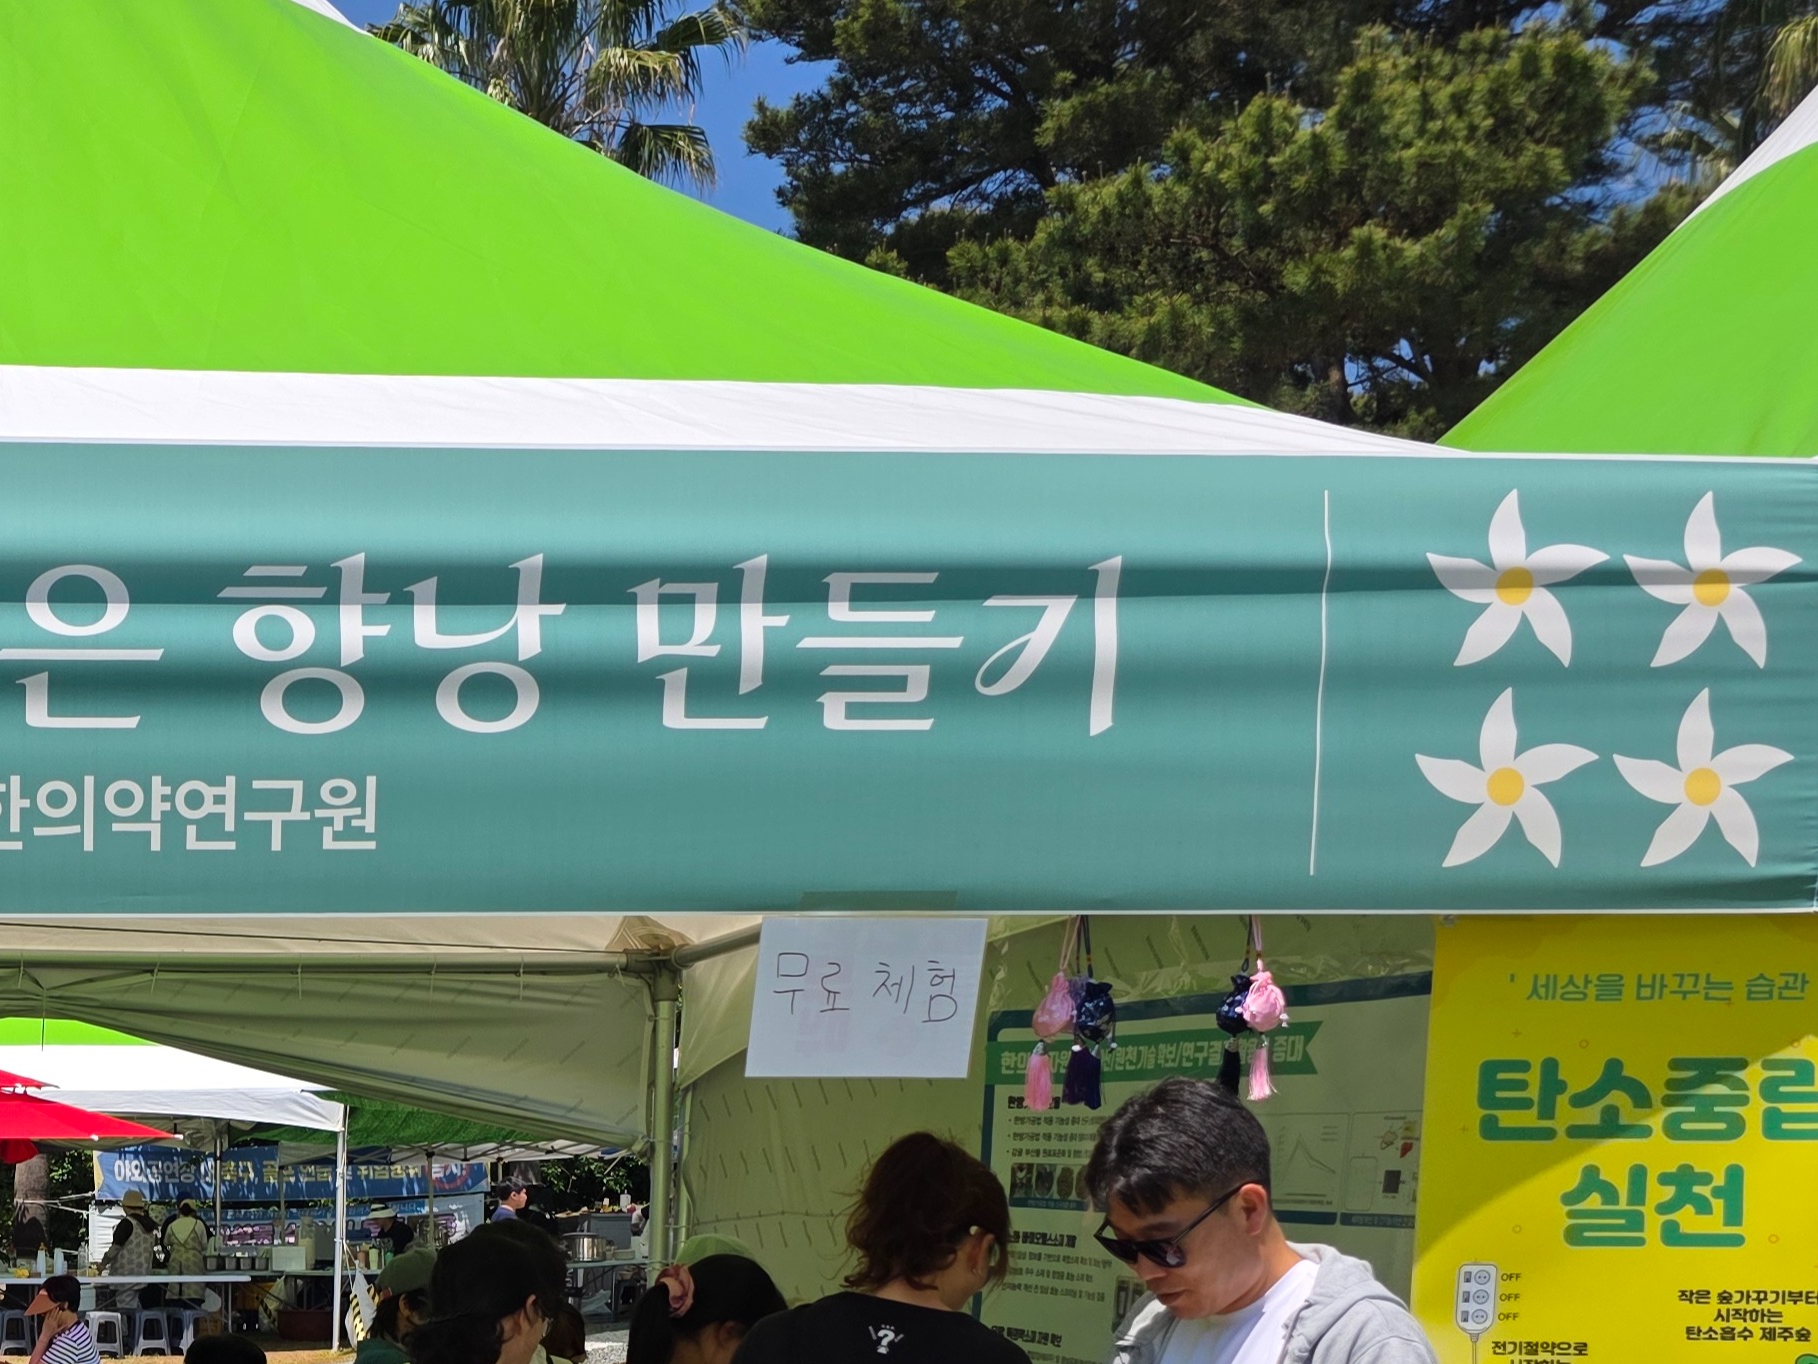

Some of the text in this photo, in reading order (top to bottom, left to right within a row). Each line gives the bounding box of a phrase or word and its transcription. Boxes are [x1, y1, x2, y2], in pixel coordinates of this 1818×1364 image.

[216, 552, 567, 735] 향낭
[627, 553, 1123, 737] 만들기
[773, 952, 958, 1023] 무료 체험
[1526, 971, 1810, 1003] 세상을 바꾸는 습관
[1559, 1163, 1746, 1249] 실천
[1500, 1272, 1522, 1282] OFF
[1499, 1292, 1521, 1302] OFF
[1677, 1289, 1712, 1306] 작은
[1498, 1312, 1520, 1322] OFF
[1713, 1307, 1784, 1324] 시작하는
[1685, 1325, 1812, 1343] 탄소흡수 제주숲
[1491, 1340, 1589, 1357] 전기절약으로
